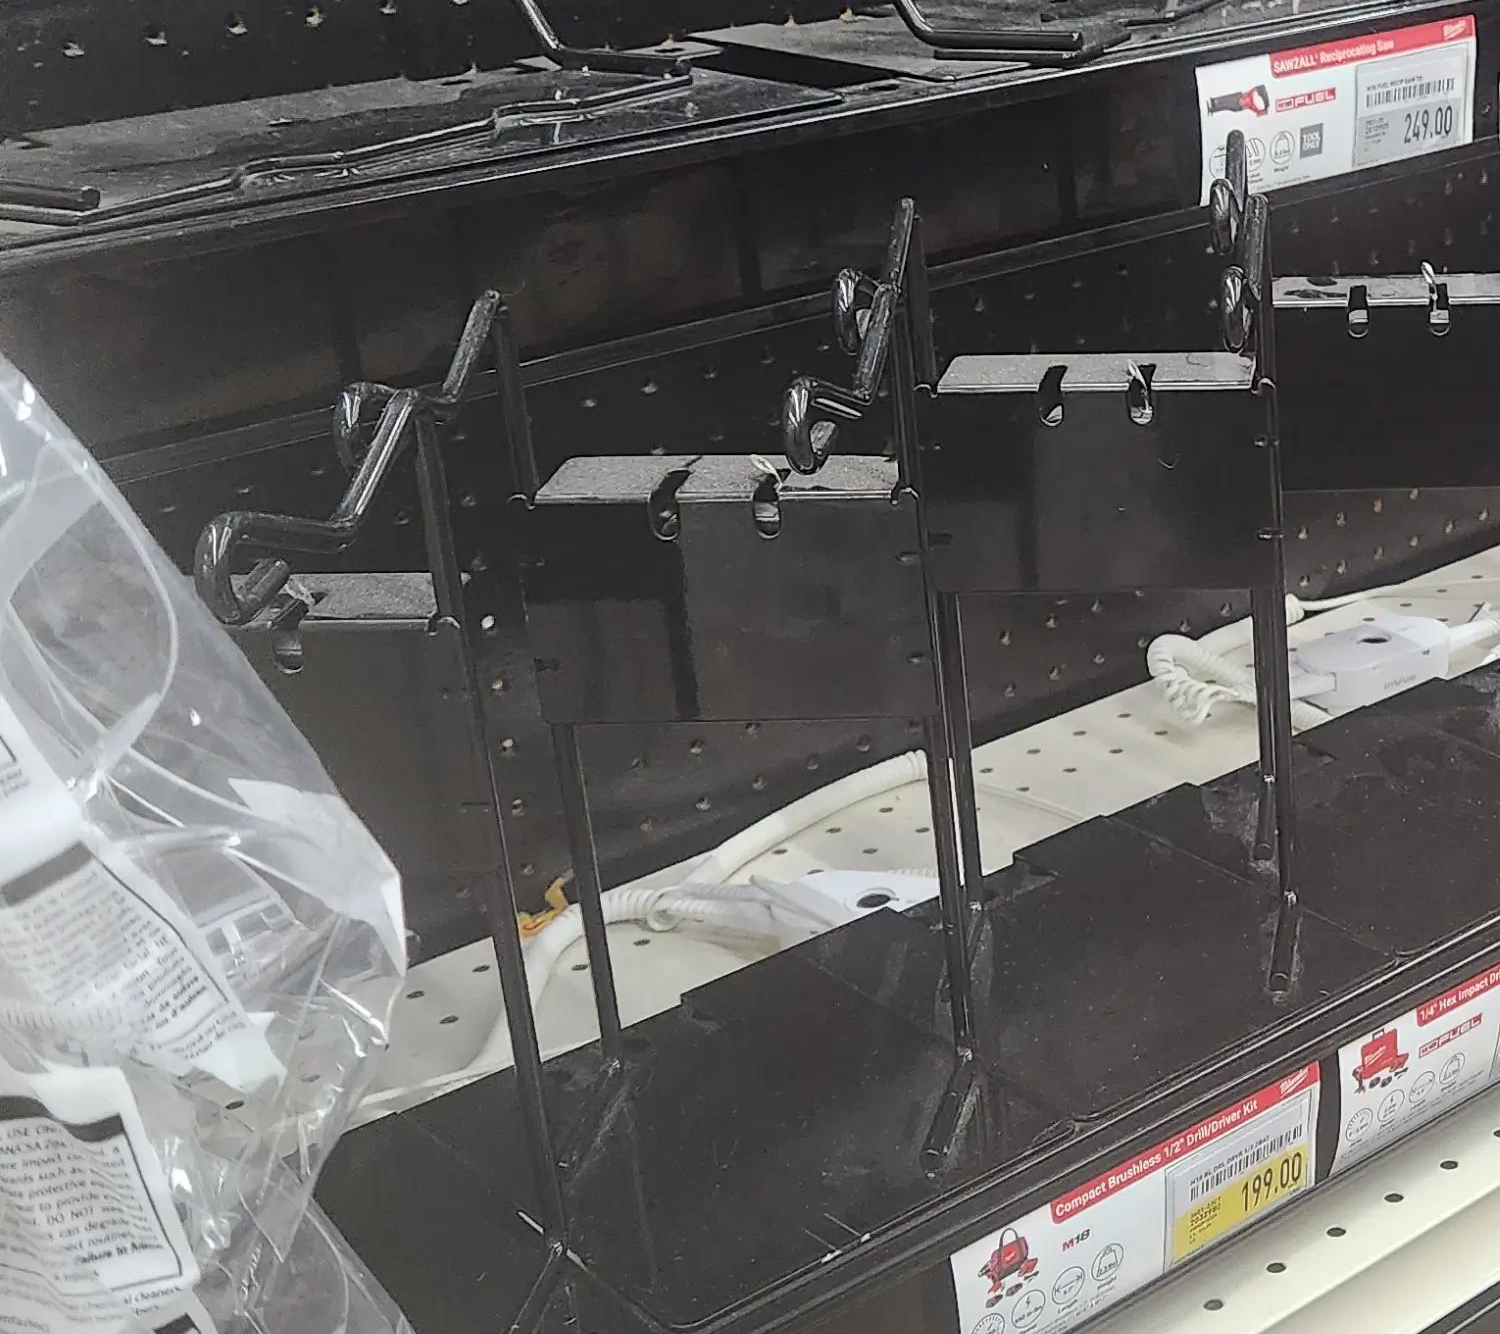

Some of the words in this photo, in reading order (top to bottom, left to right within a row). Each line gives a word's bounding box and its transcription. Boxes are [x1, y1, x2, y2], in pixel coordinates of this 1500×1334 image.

[1320, 42, 1377, 66] Reciprocating
[1294, 88, 1336, 109] FUEL
[1403, 105, 1453, 144] 249.00
[1420, 1002, 1438, 1022] 1/4"
[1439, 994, 1458, 1012] Hex
[1458, 977, 1490, 1005] Impact
[1439, 1012, 1484, 1047] FUEL
[1055, 1183, 1107, 1218] Compact
[1108, 1154, 1162, 1190] Brushless
[1163, 1137, 1185, 1159] 1/2"
[1186, 1112, 1242, 1147] Drill/Driver
[1242, 1100, 1259, 1116] Kit
[1240, 1151, 1303, 1213] 199.00
[1062, 1229, 1092, 1252] M18
